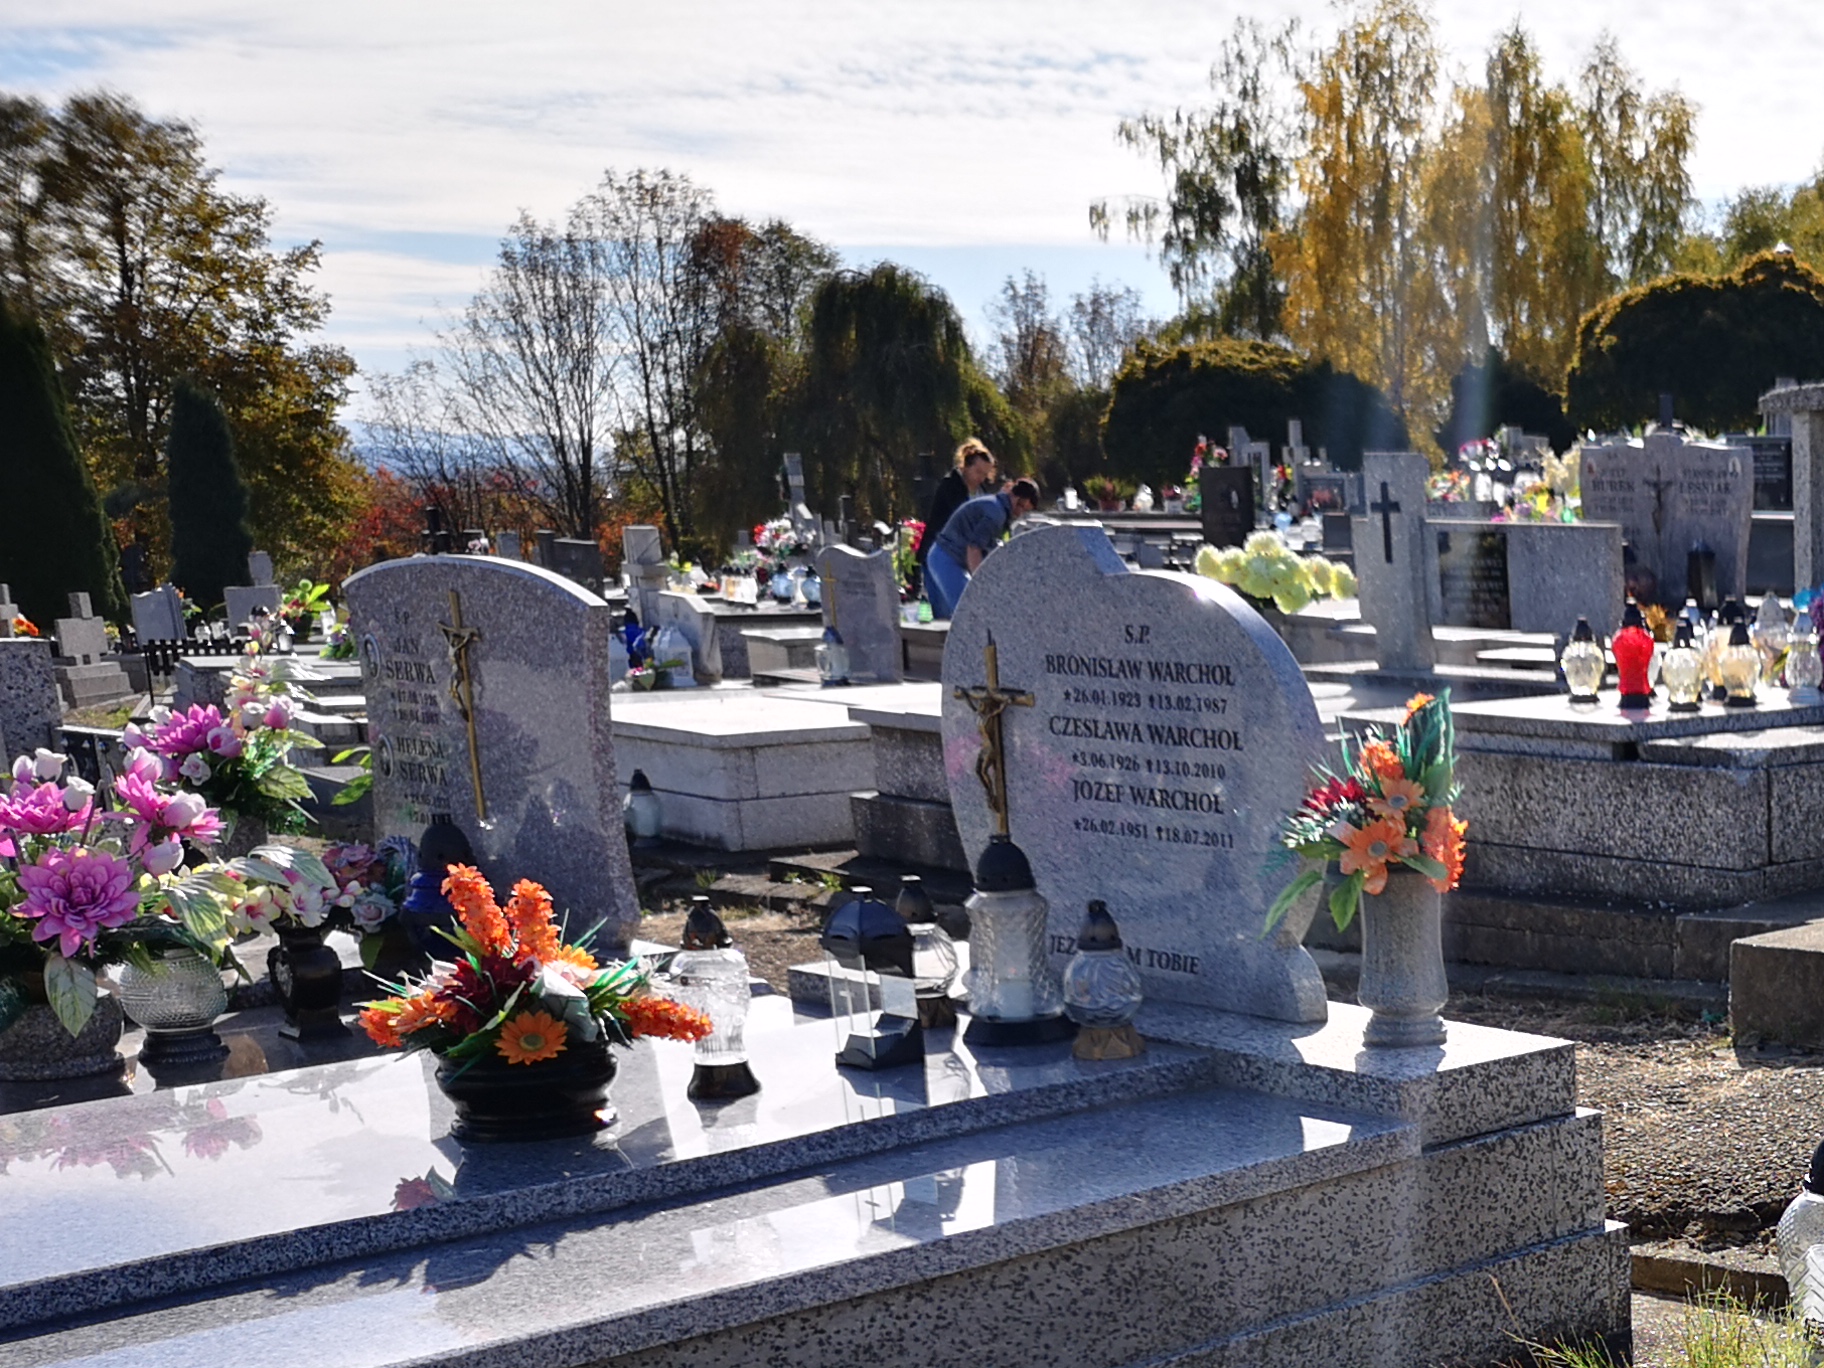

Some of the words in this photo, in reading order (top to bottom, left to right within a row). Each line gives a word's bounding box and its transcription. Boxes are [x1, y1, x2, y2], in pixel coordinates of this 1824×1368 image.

[386, 660, 436, 684] SERWA
[396, 737, 445, 759] HELENA
[400, 763, 448, 786] SERWA
[1050, 935, 1077, 956] JEZ
[1148, 948, 1200, 975] TOBIE
